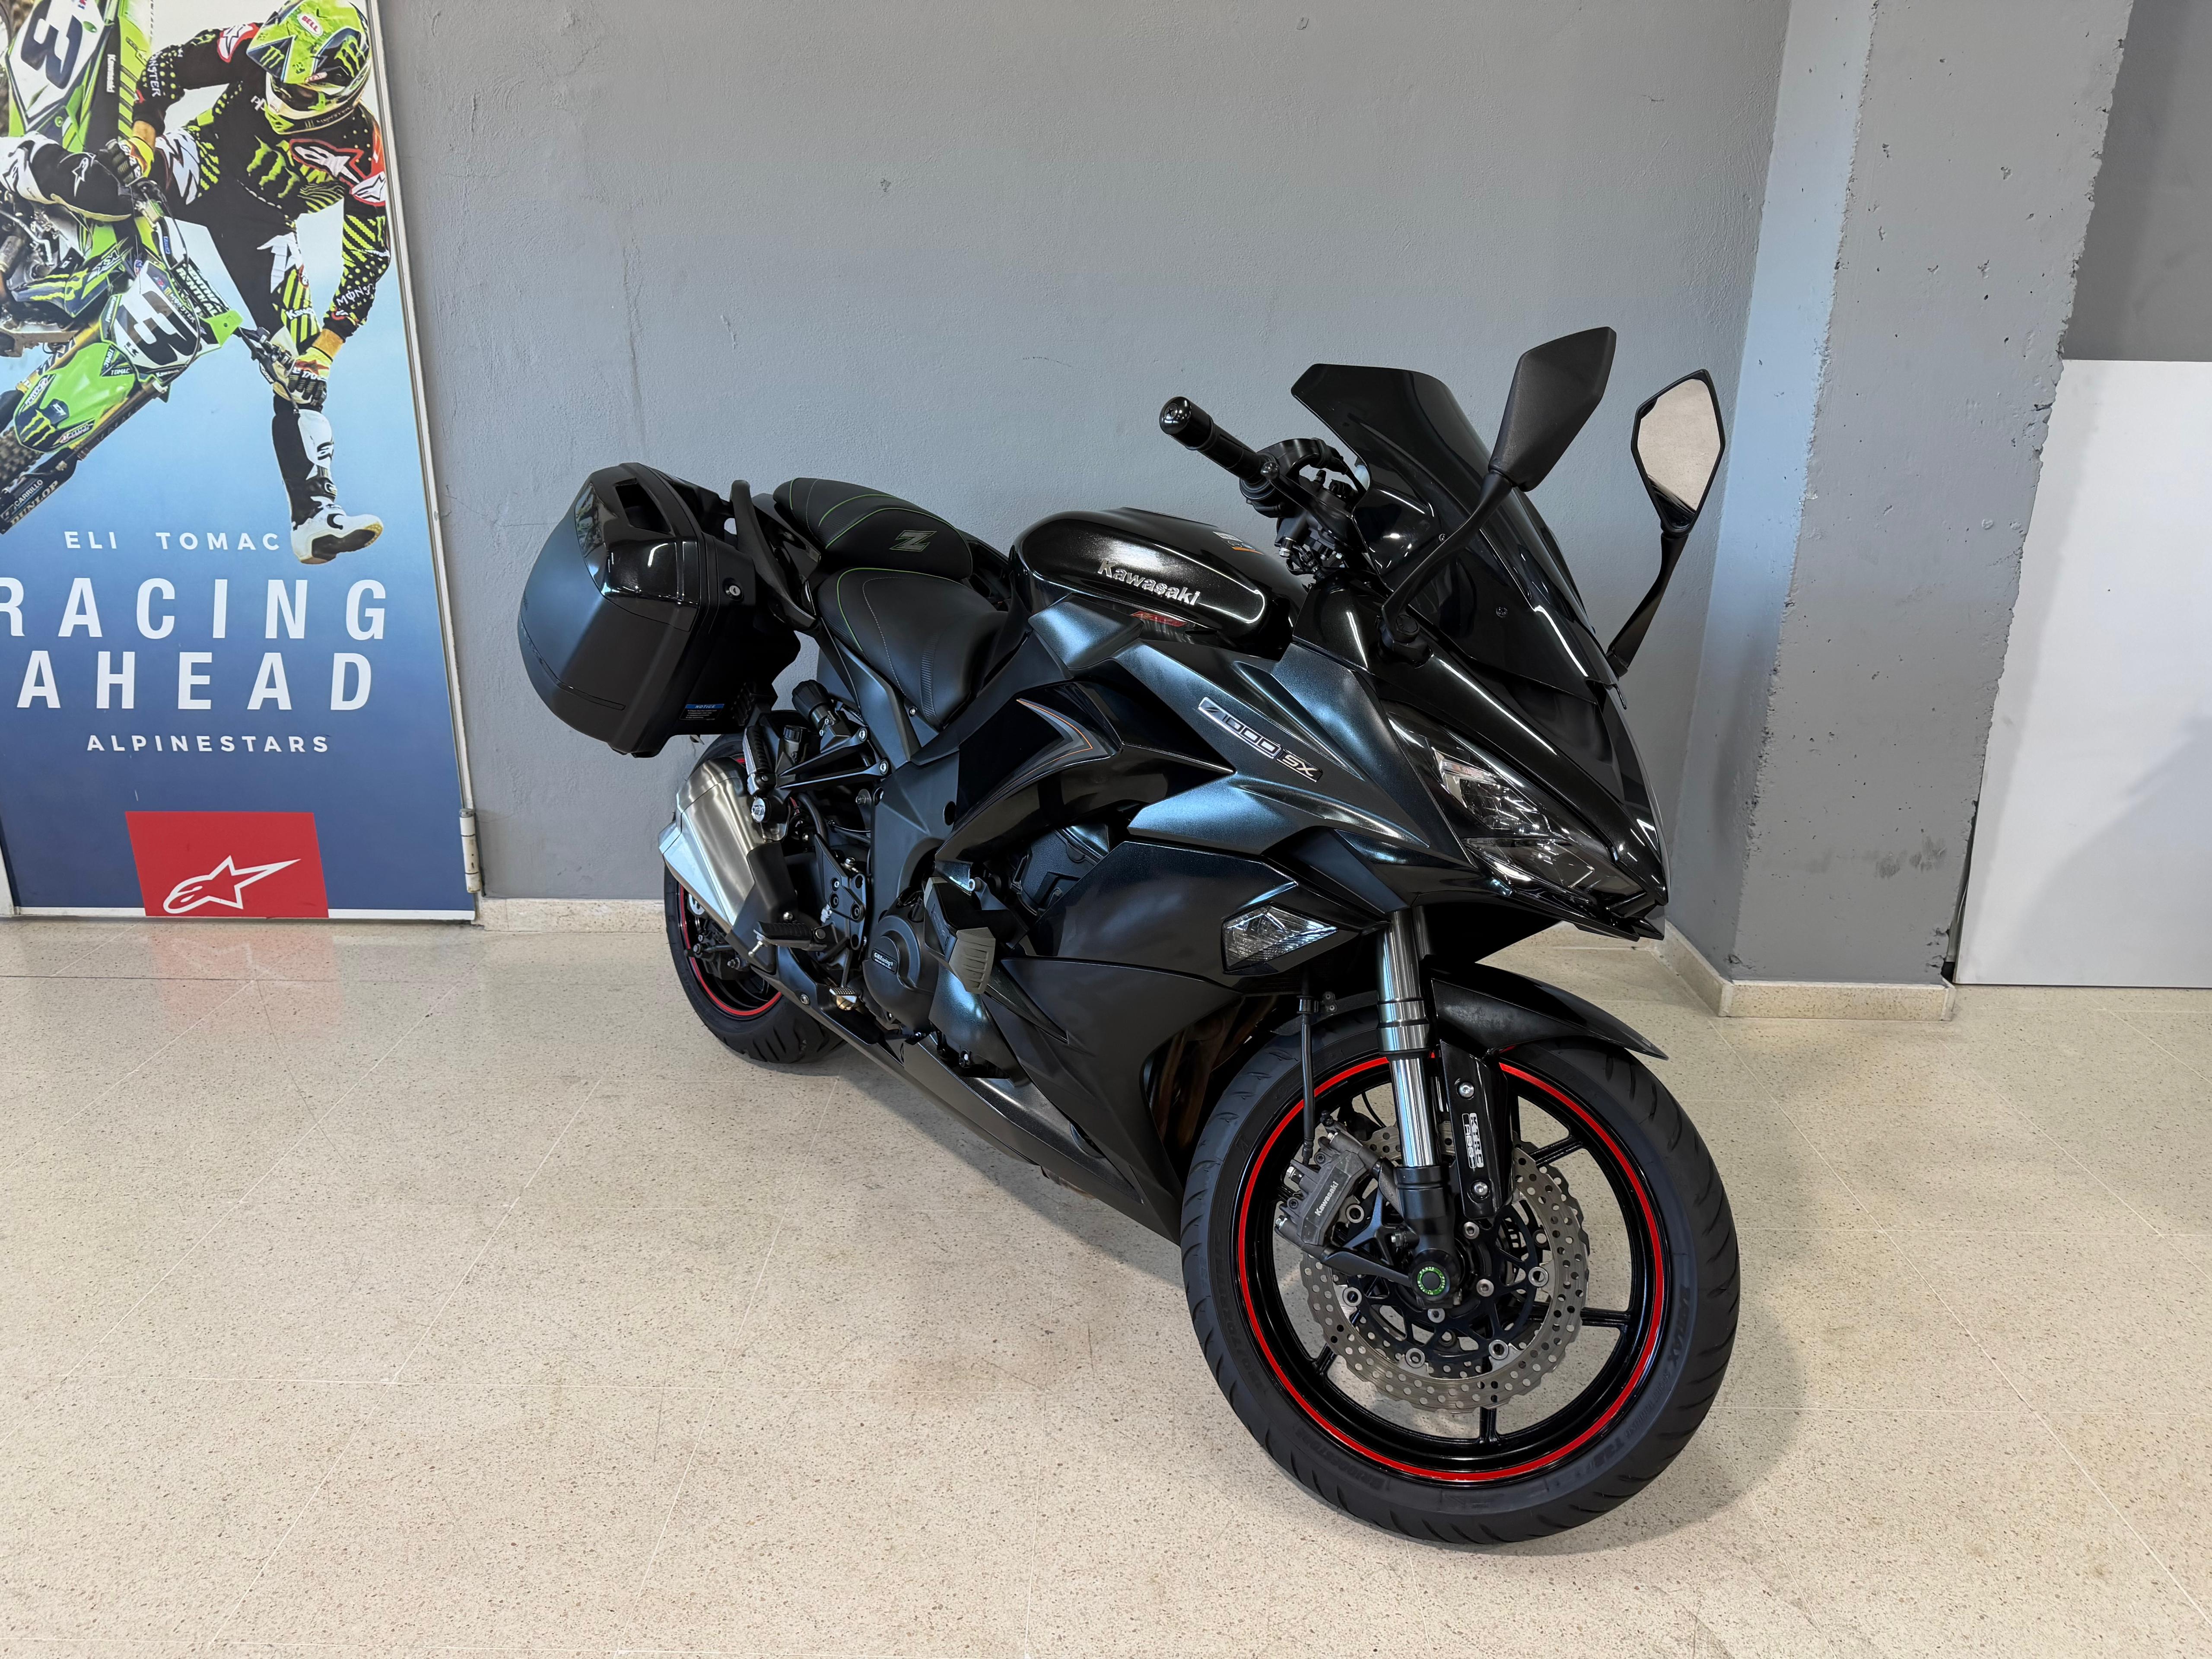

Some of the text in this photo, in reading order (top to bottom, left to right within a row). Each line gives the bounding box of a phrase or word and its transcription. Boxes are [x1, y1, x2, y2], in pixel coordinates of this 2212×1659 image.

[302, 16, 319, 32] BELL
[10, 480, 58, 525] DUNLOP
[14, 480, 43, 507] CARRILLO
[64, 531, 280, 550] ELI TOMAC
[890, 530, 937, 551] Z
[1098, 559, 1200, 605] Kawasaki
[0, 577, 386, 640] RACING
[17, 651, 372, 710] AHEAD
[87, 735, 328, 752] ALPINESTARS
[1282, 754, 1319, 777] SX
[1464, 1124, 1474, 1158] ABS
[1471, 1116, 1483, 1163] KTRC
[1314, 1181, 1339, 1216] Kawasaki
